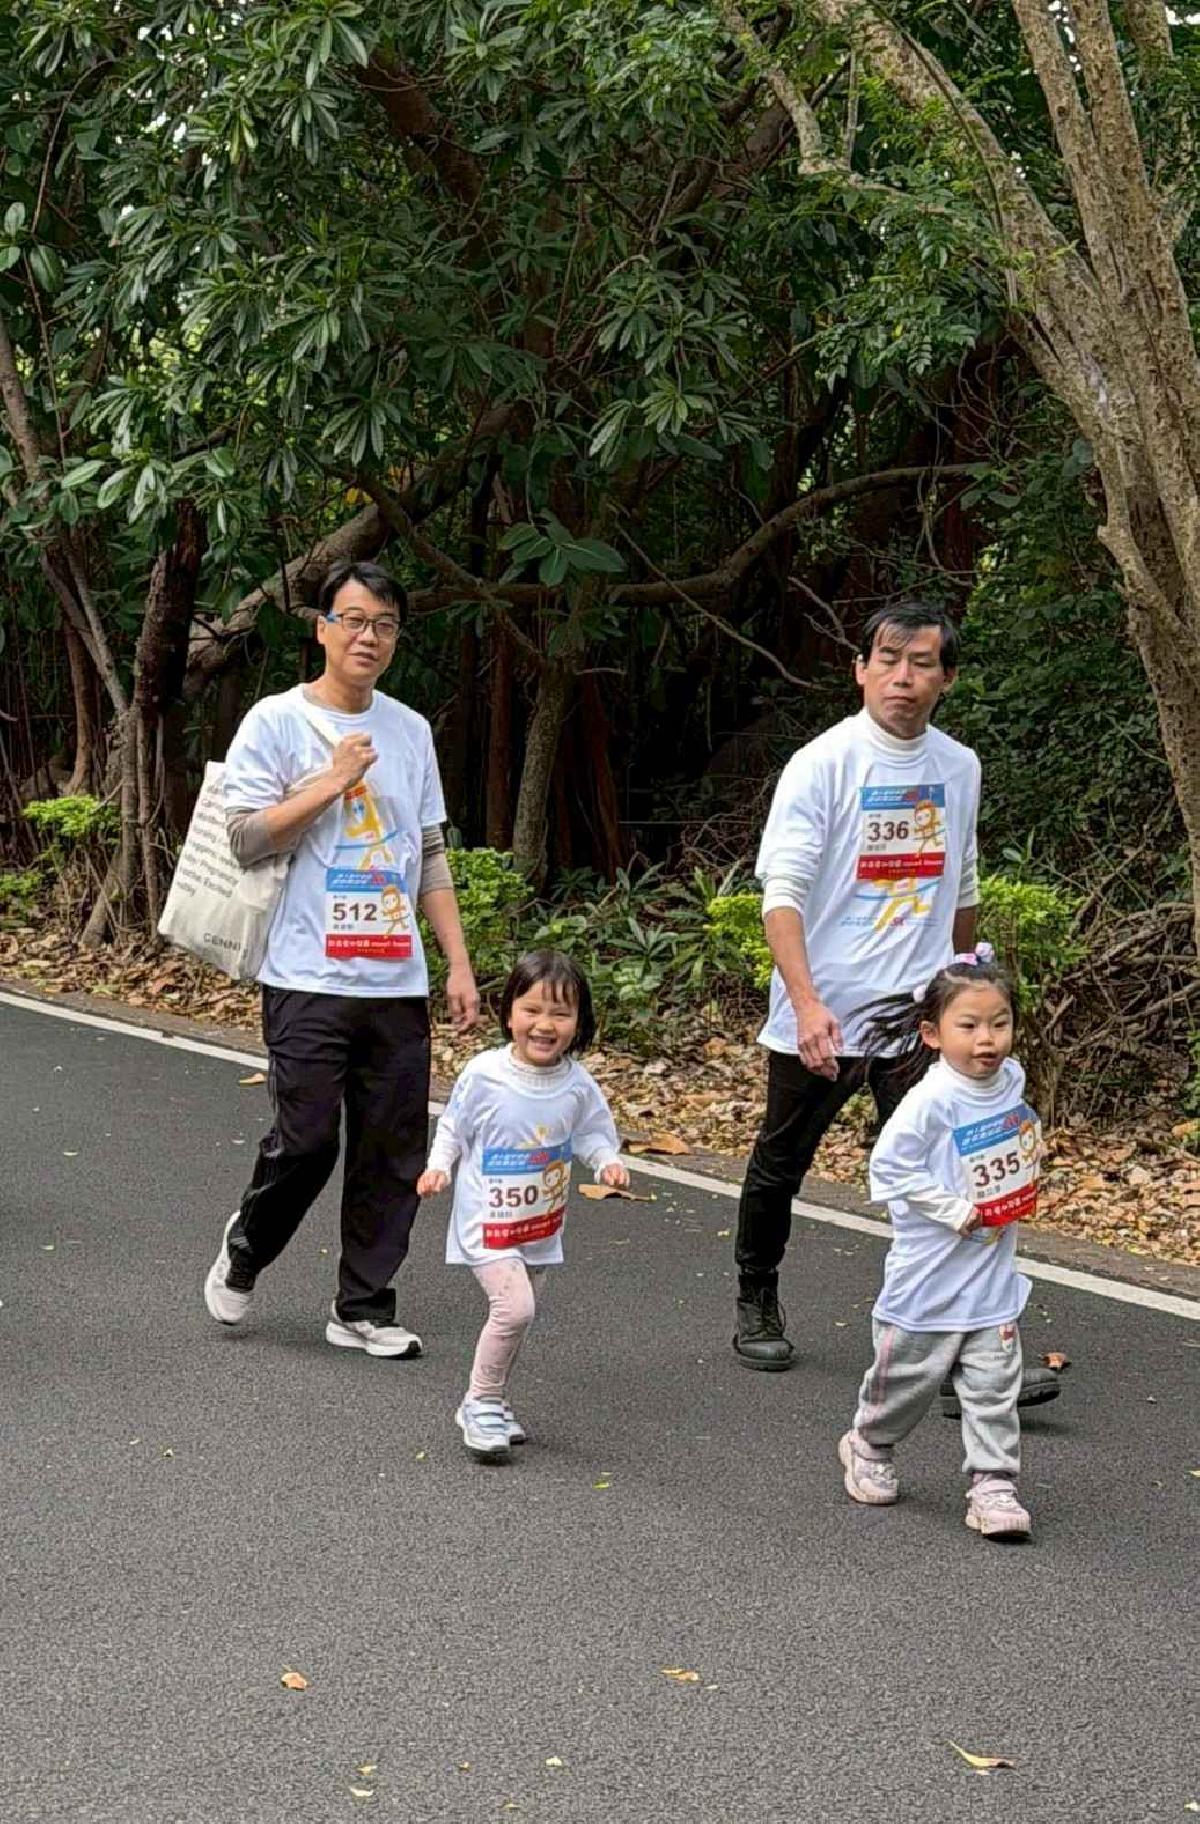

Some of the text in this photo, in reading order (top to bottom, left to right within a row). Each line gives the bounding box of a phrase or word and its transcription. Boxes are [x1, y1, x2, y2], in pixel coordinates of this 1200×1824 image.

[868, 821, 909, 841] 336
[333, 903, 377, 921] 512
[972, 1152, 1020, 1187] 335
[489, 1185, 539, 1209] 350
